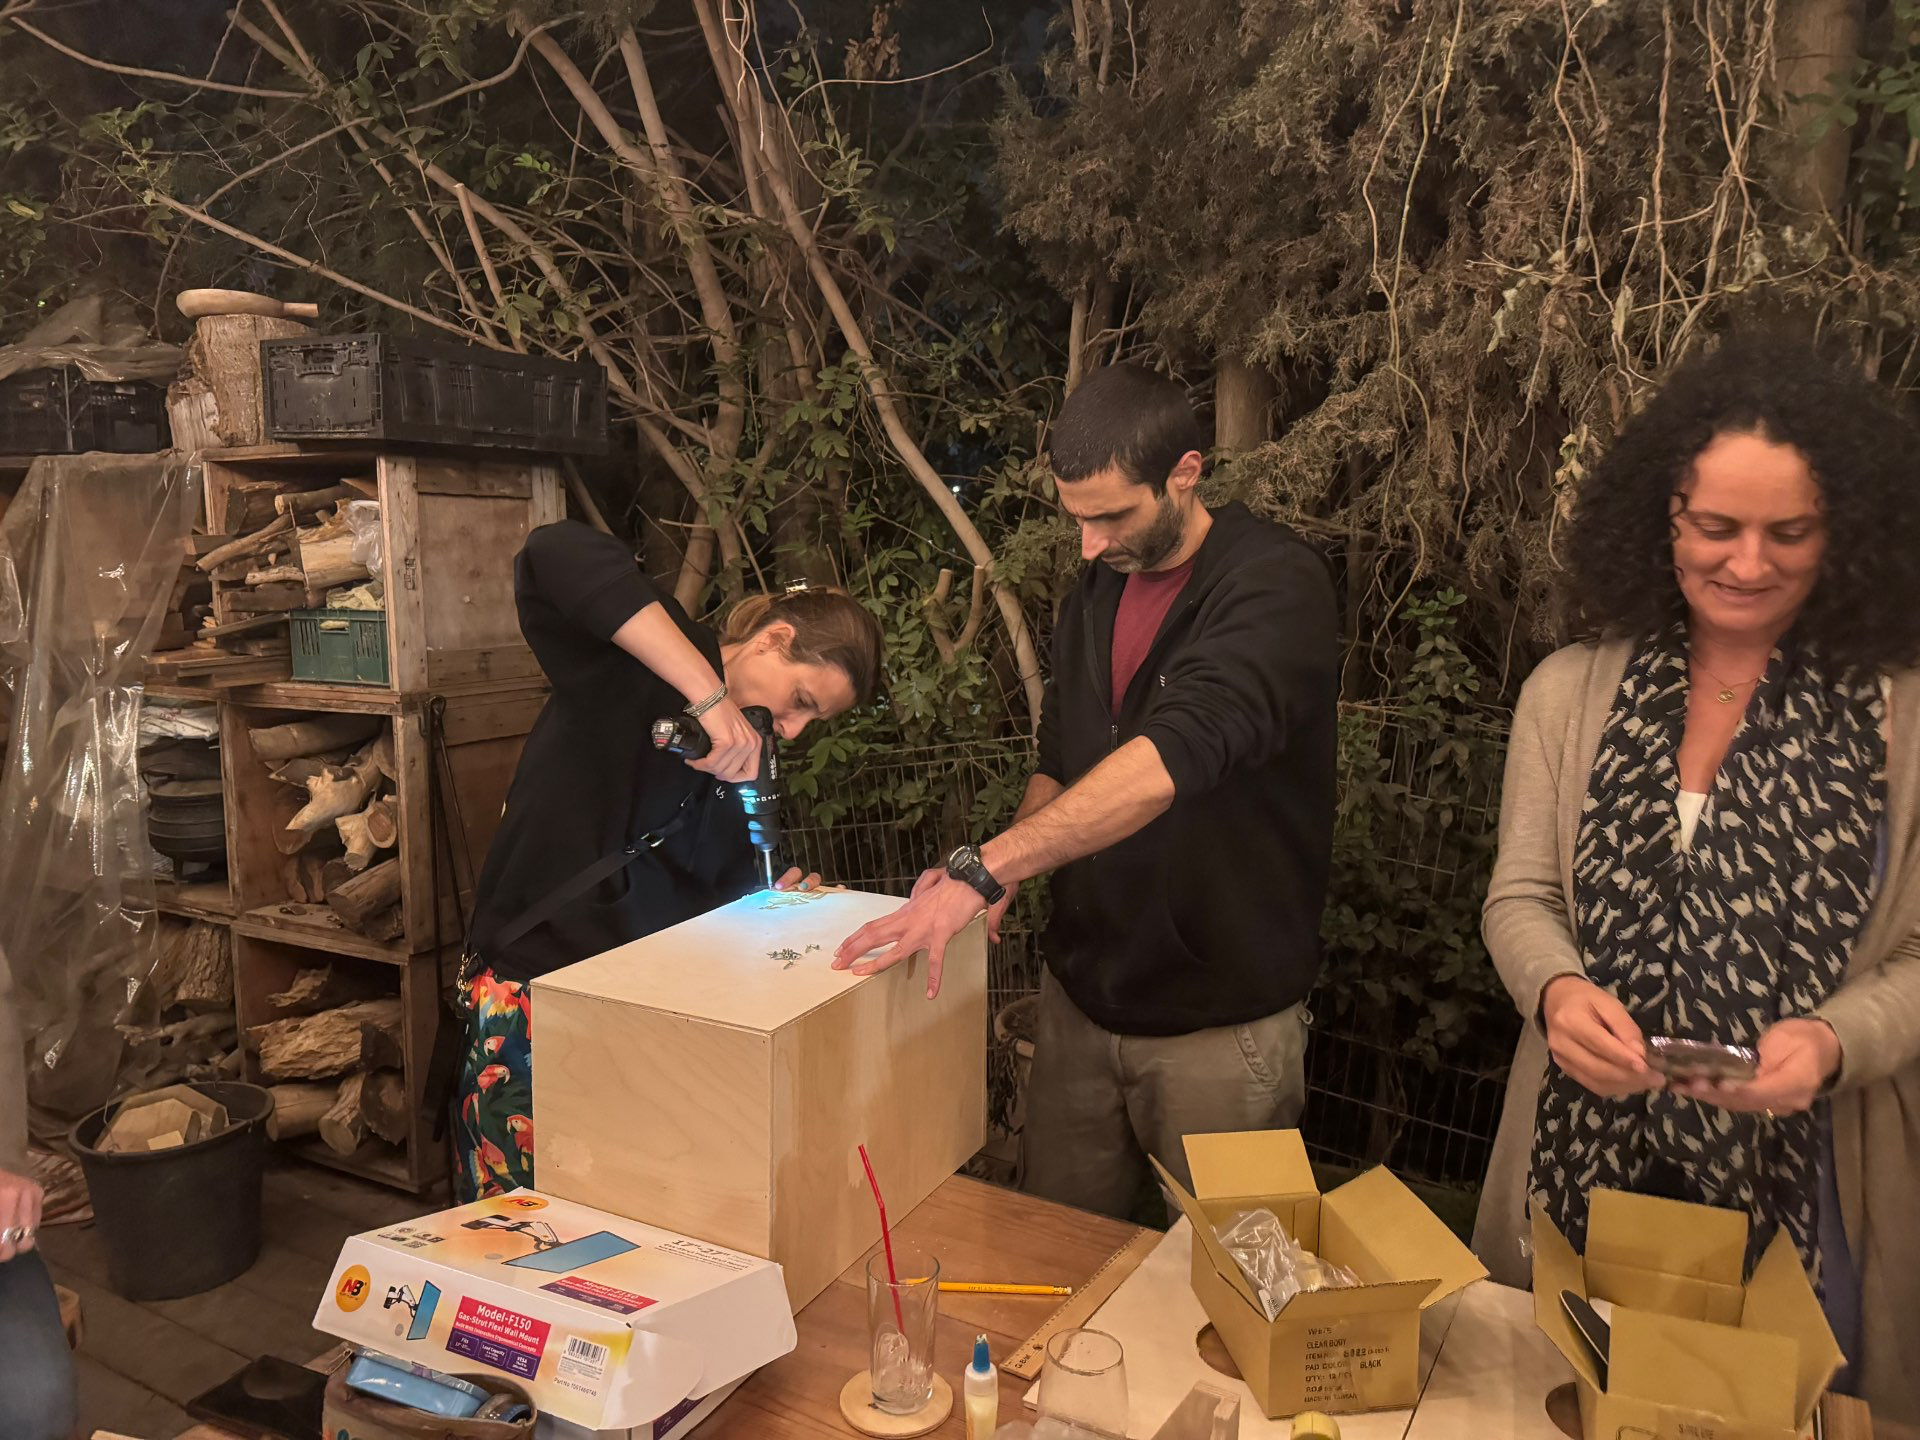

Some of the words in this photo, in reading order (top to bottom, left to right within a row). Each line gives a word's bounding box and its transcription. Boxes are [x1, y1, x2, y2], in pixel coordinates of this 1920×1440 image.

[341, 1279, 365, 1297] NB
[458, 1311, 488, 1328] Gas-Strut
[487, 1321, 503, 1333] Flexi
[503, 1326, 519, 1338] Wall
[518, 1331, 540, 1345] Mount
[476, 1304, 532, 1331] Model-F150
[1360, 1359, 1382, 1369] BLACK
